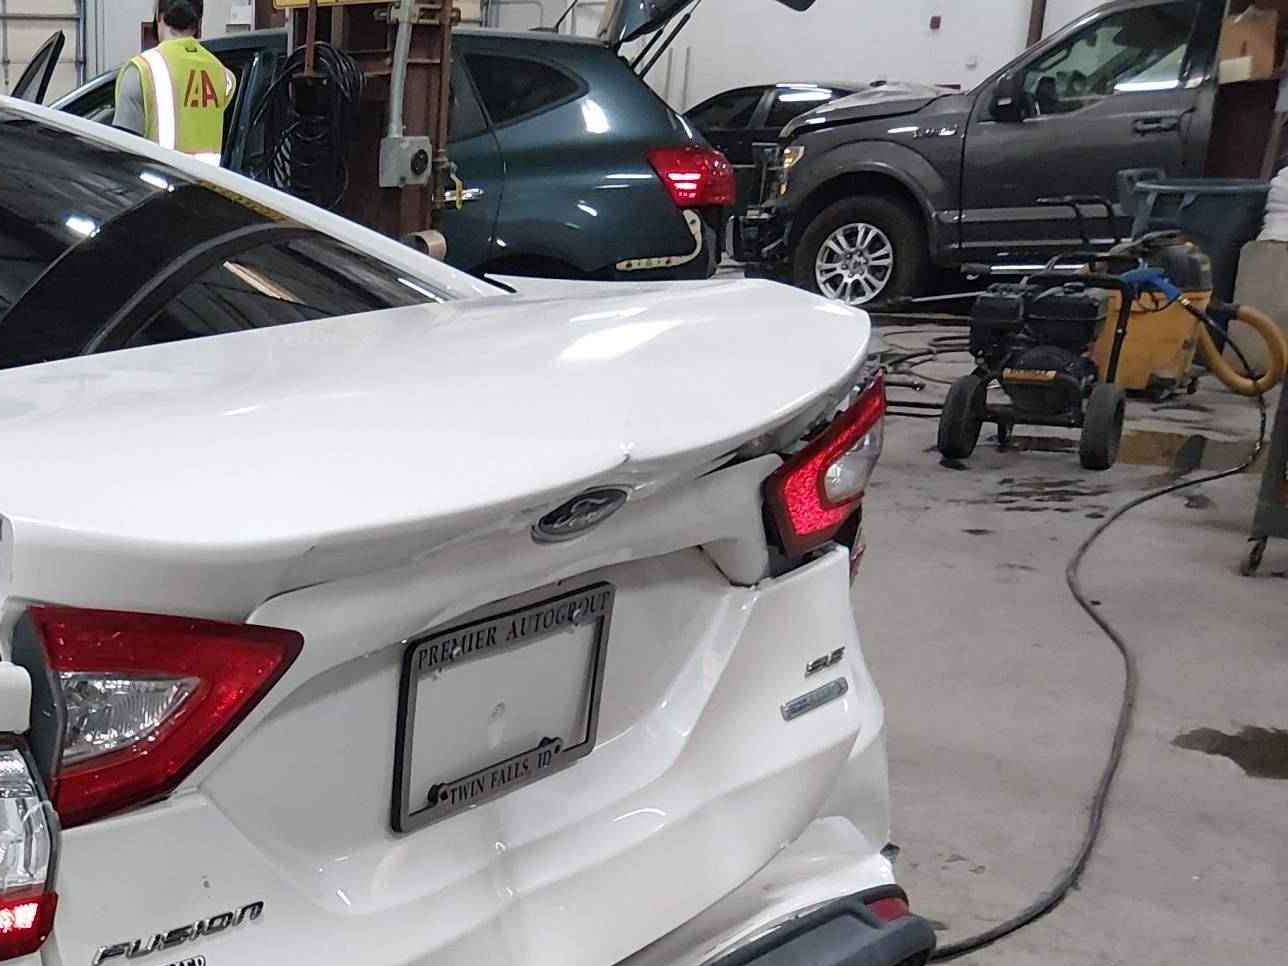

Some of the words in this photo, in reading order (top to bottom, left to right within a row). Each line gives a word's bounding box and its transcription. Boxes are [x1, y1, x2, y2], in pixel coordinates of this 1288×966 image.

[417, 626, 498, 670] PREMIER
[505, 590, 611, 643] AUTOGROUP
[450, 776, 485, 805] TWIN
[490, 758, 532, 789] FALLS,
[537, 749, 553, 769] ID
